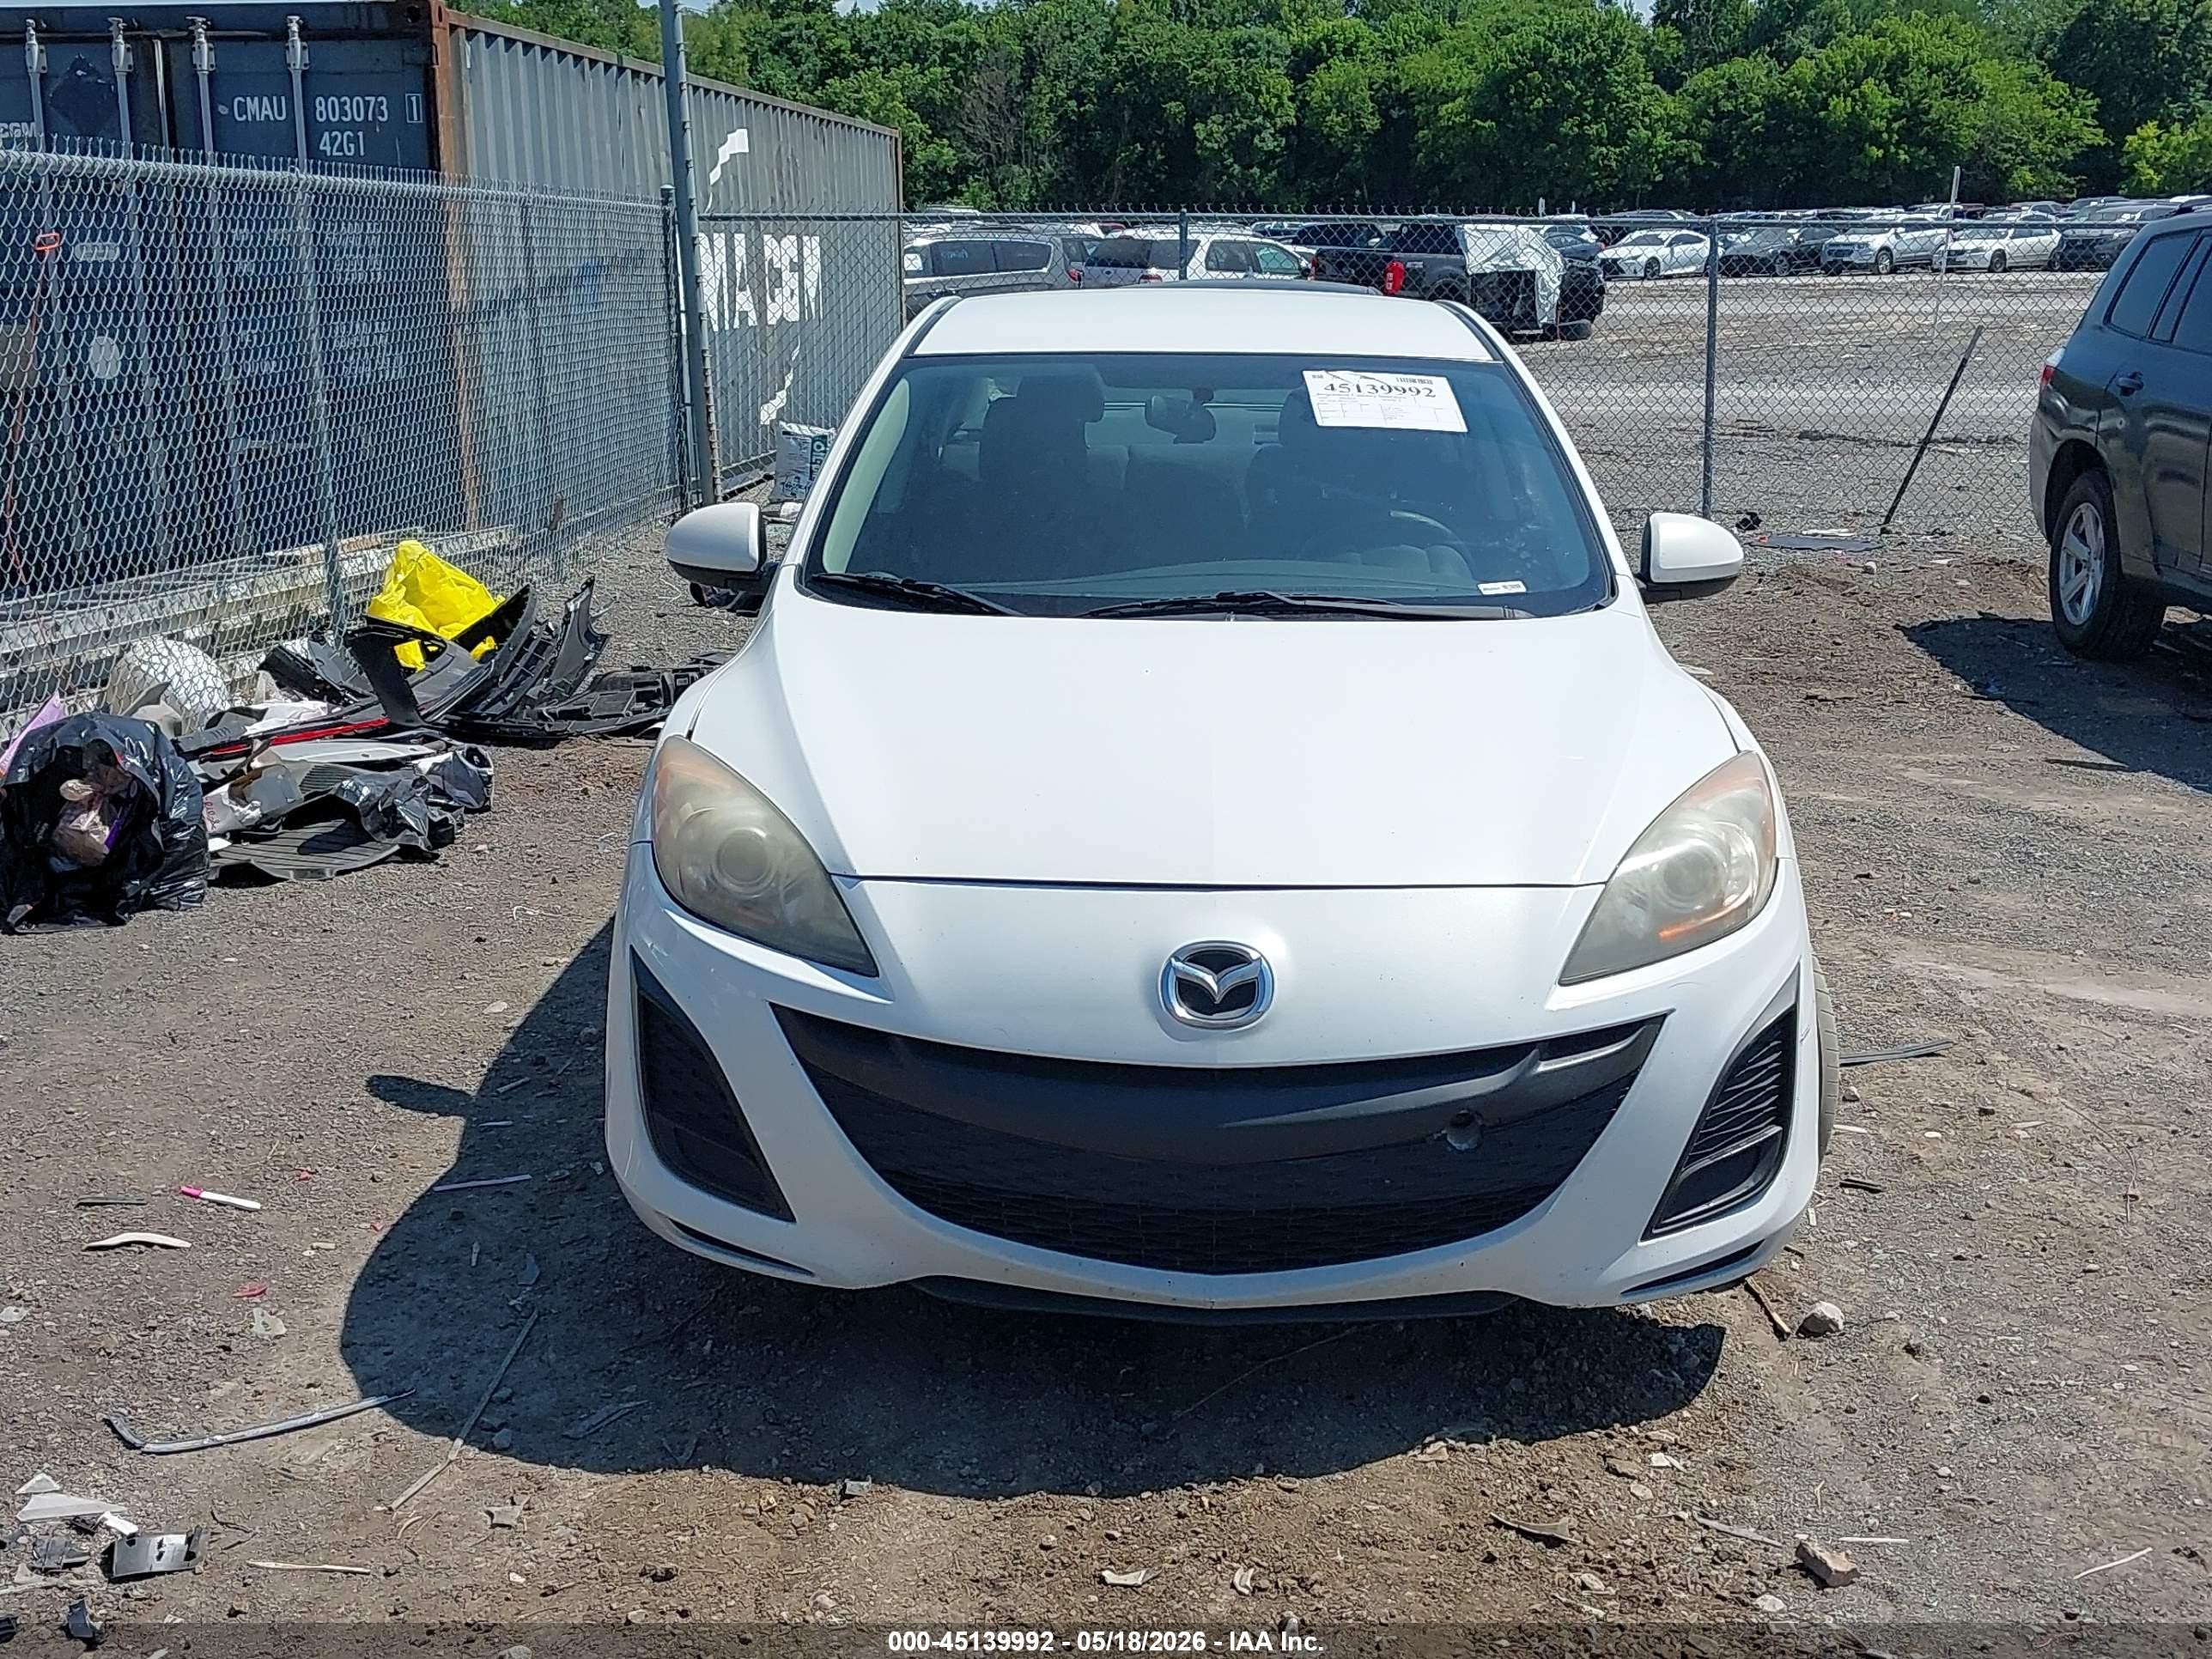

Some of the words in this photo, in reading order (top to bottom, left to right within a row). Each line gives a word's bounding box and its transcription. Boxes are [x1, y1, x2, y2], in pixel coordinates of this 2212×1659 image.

[233, 95, 287, 122] CMAU
[315, 95, 388, 122] 803073
[319, 131, 365, 157] 42G1
[763, 234, 823, 325] CGM
[1323, 383, 1437, 398] 45139992
